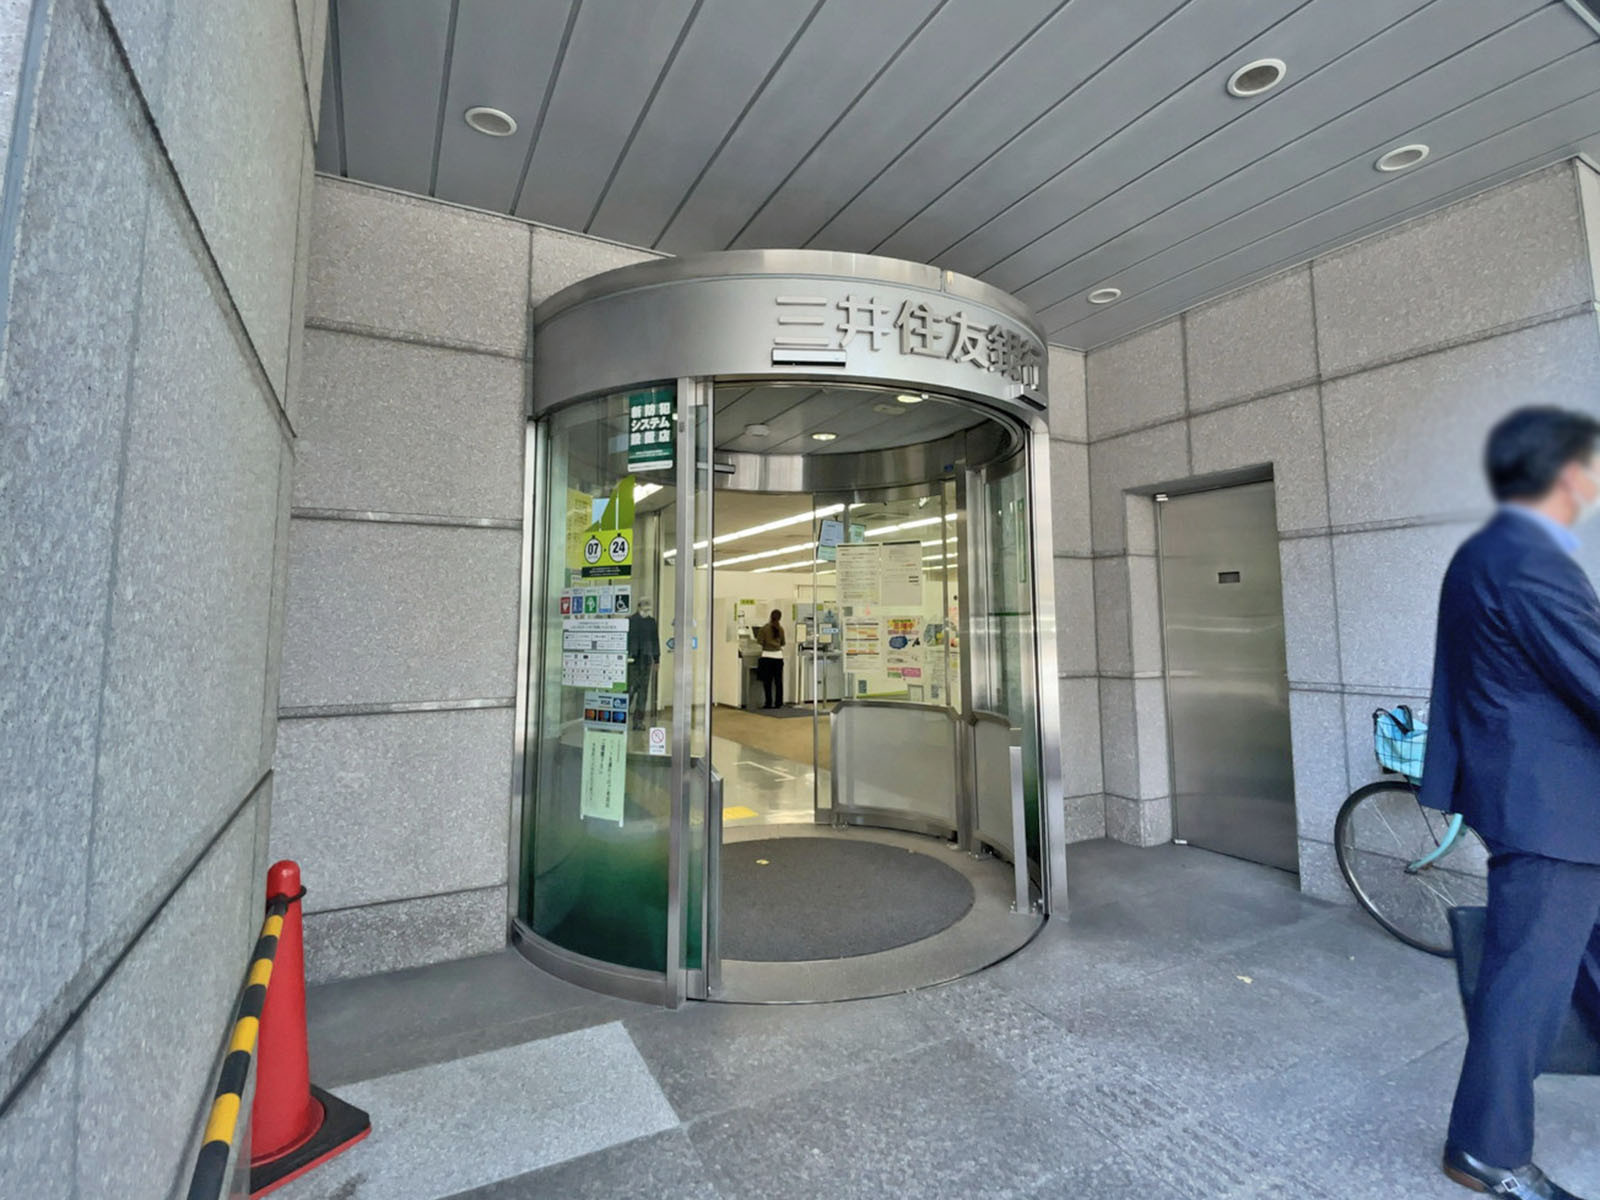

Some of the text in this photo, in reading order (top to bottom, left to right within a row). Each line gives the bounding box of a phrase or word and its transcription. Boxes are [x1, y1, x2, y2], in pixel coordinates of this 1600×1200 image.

[631, 416, 670, 432] システム
[587, 541, 625, 555] 07 24
